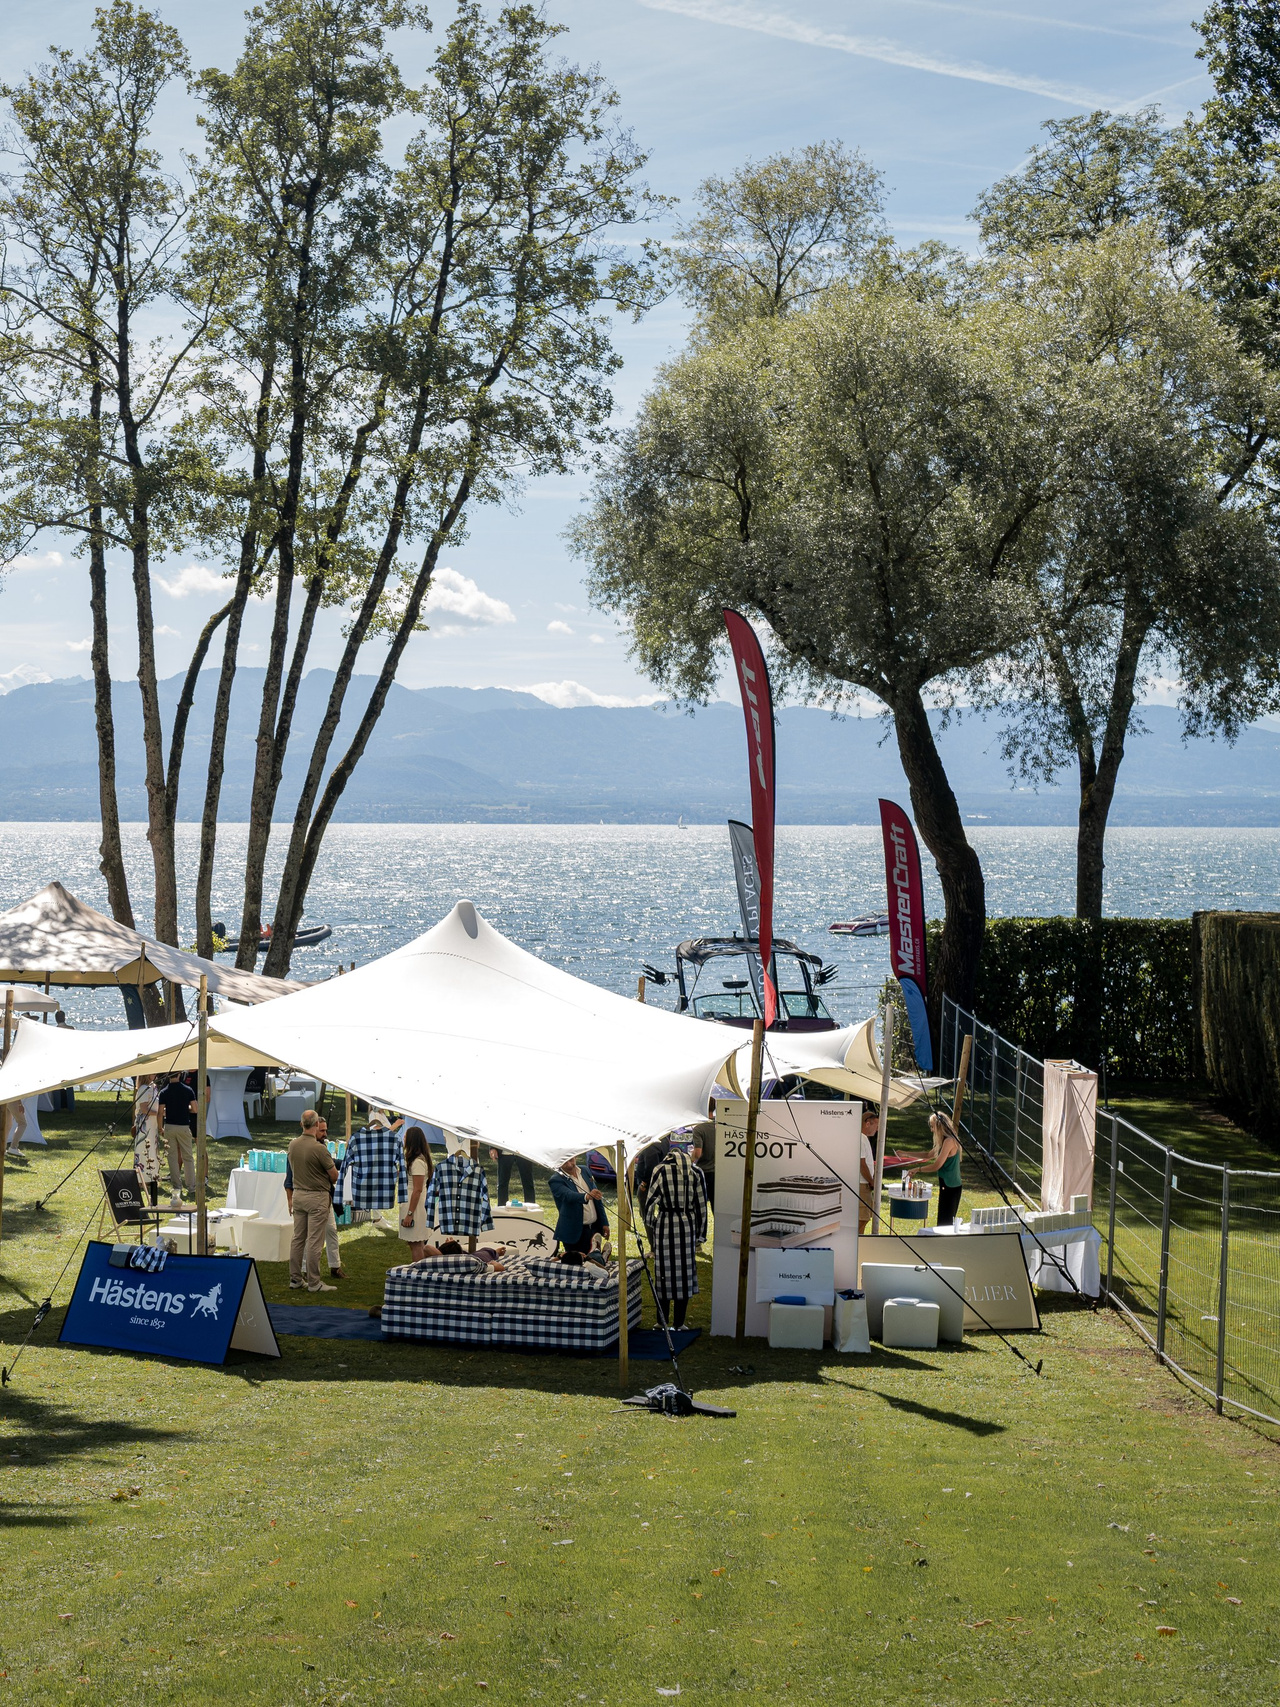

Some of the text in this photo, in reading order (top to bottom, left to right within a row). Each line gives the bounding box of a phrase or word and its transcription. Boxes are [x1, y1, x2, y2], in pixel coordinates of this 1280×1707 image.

[889, 822, 915, 975] MasterCraft
[724, 1129, 770, 1140] HÄSNS
[724, 1140, 797, 1159] 2000T
[778, 1272, 803, 1280] Hästens
[88, 1276, 186, 1315] Hästens
[129, 1314, 166, 1330] since 1852
